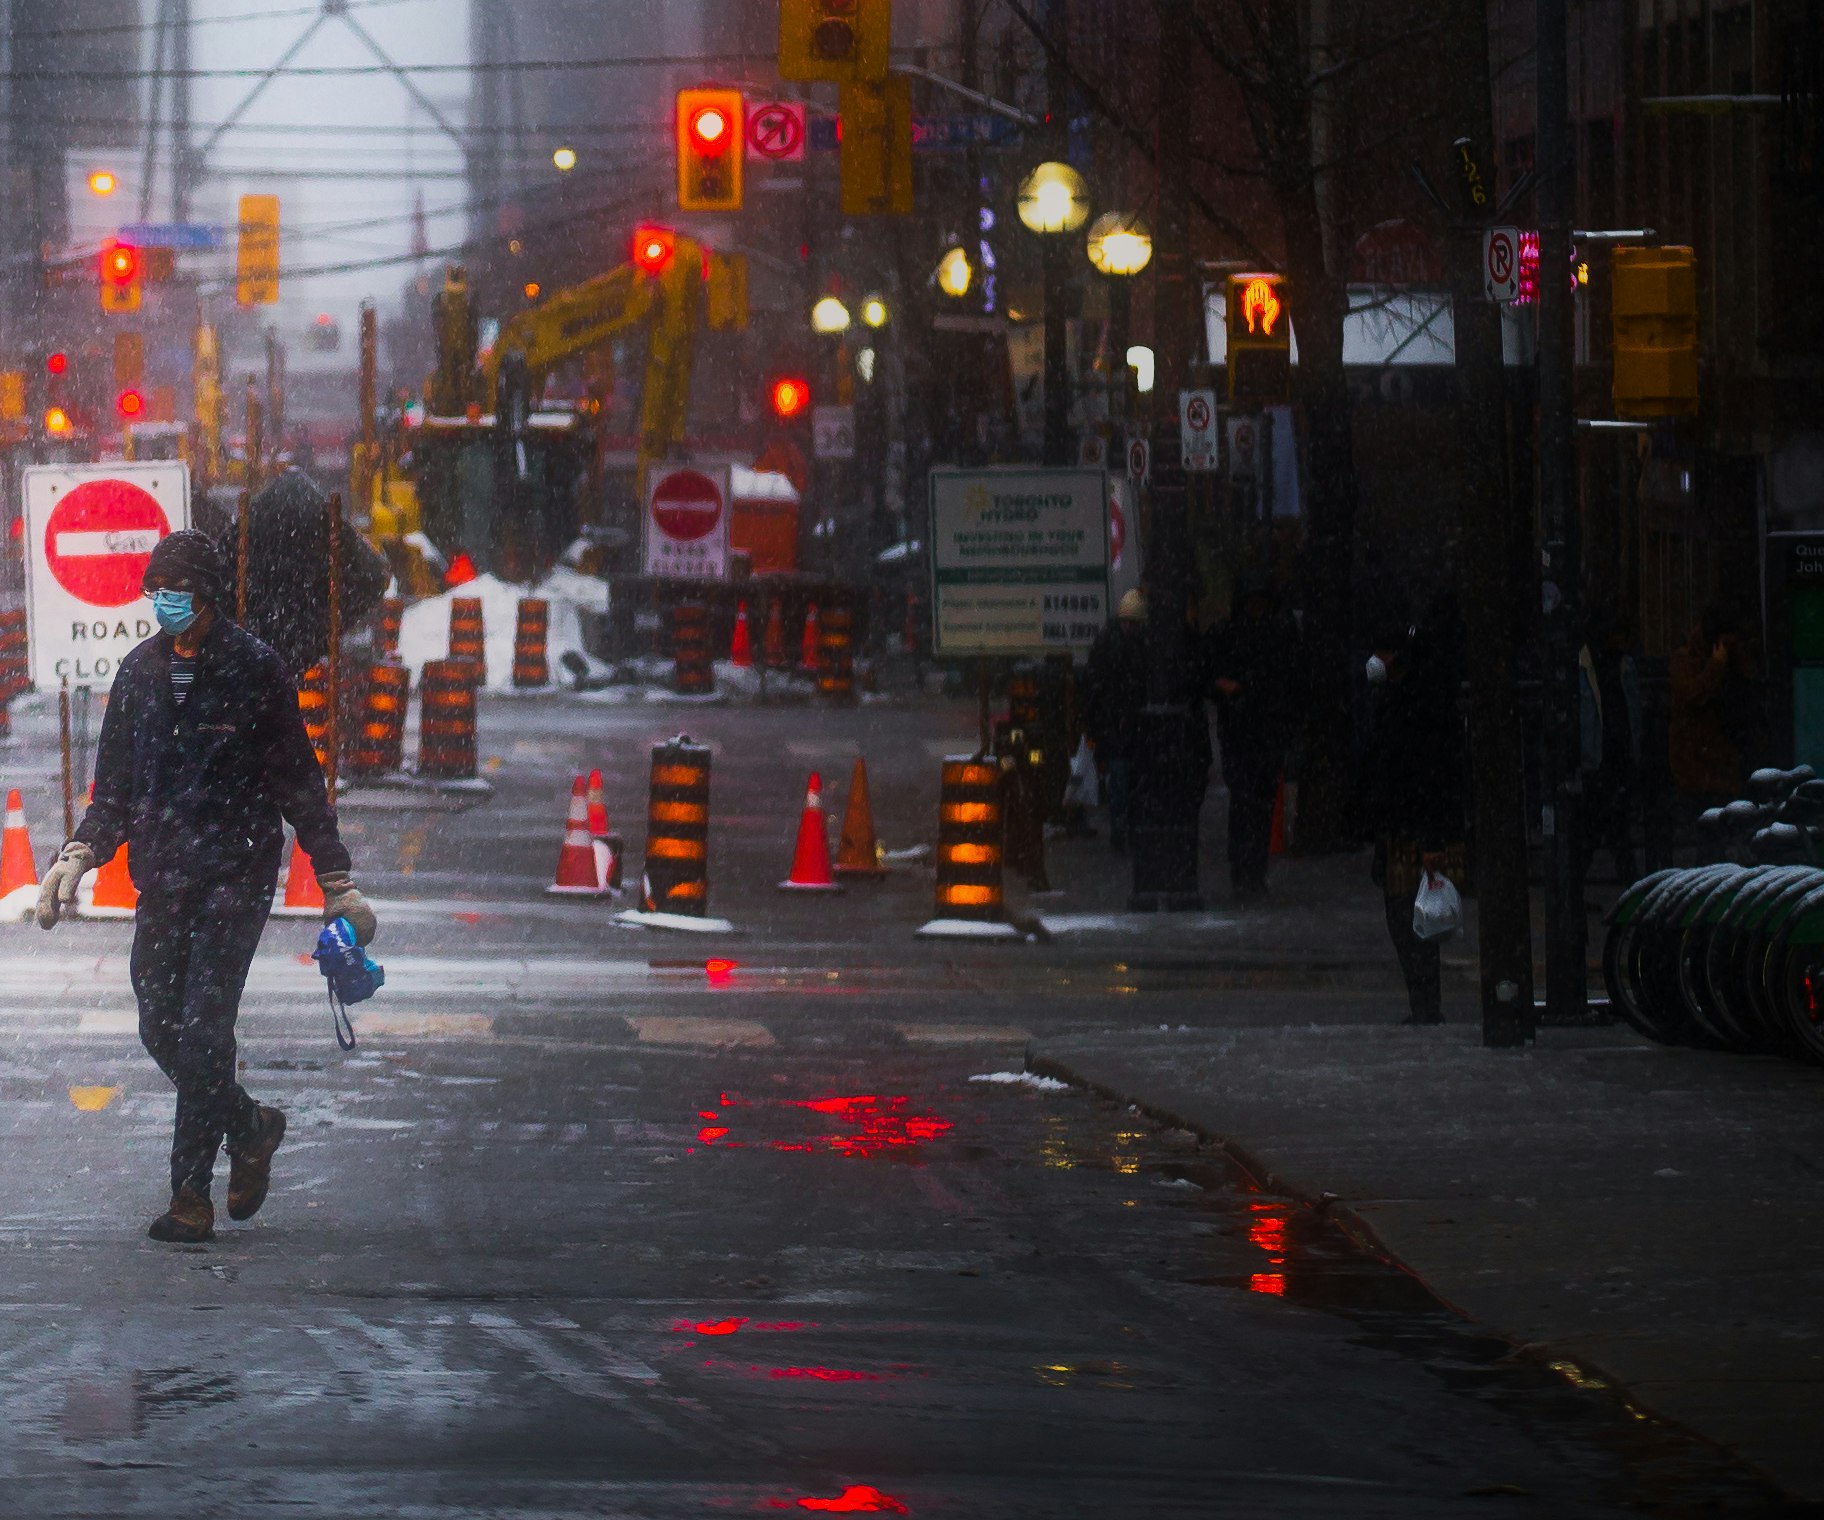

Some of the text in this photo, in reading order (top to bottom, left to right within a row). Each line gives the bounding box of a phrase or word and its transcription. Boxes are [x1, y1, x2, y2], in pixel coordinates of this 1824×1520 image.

[1460, 146, 1488, 206] 126
[71, 619, 152, 641] ROAD
[55, 657, 119, 678] CLO
